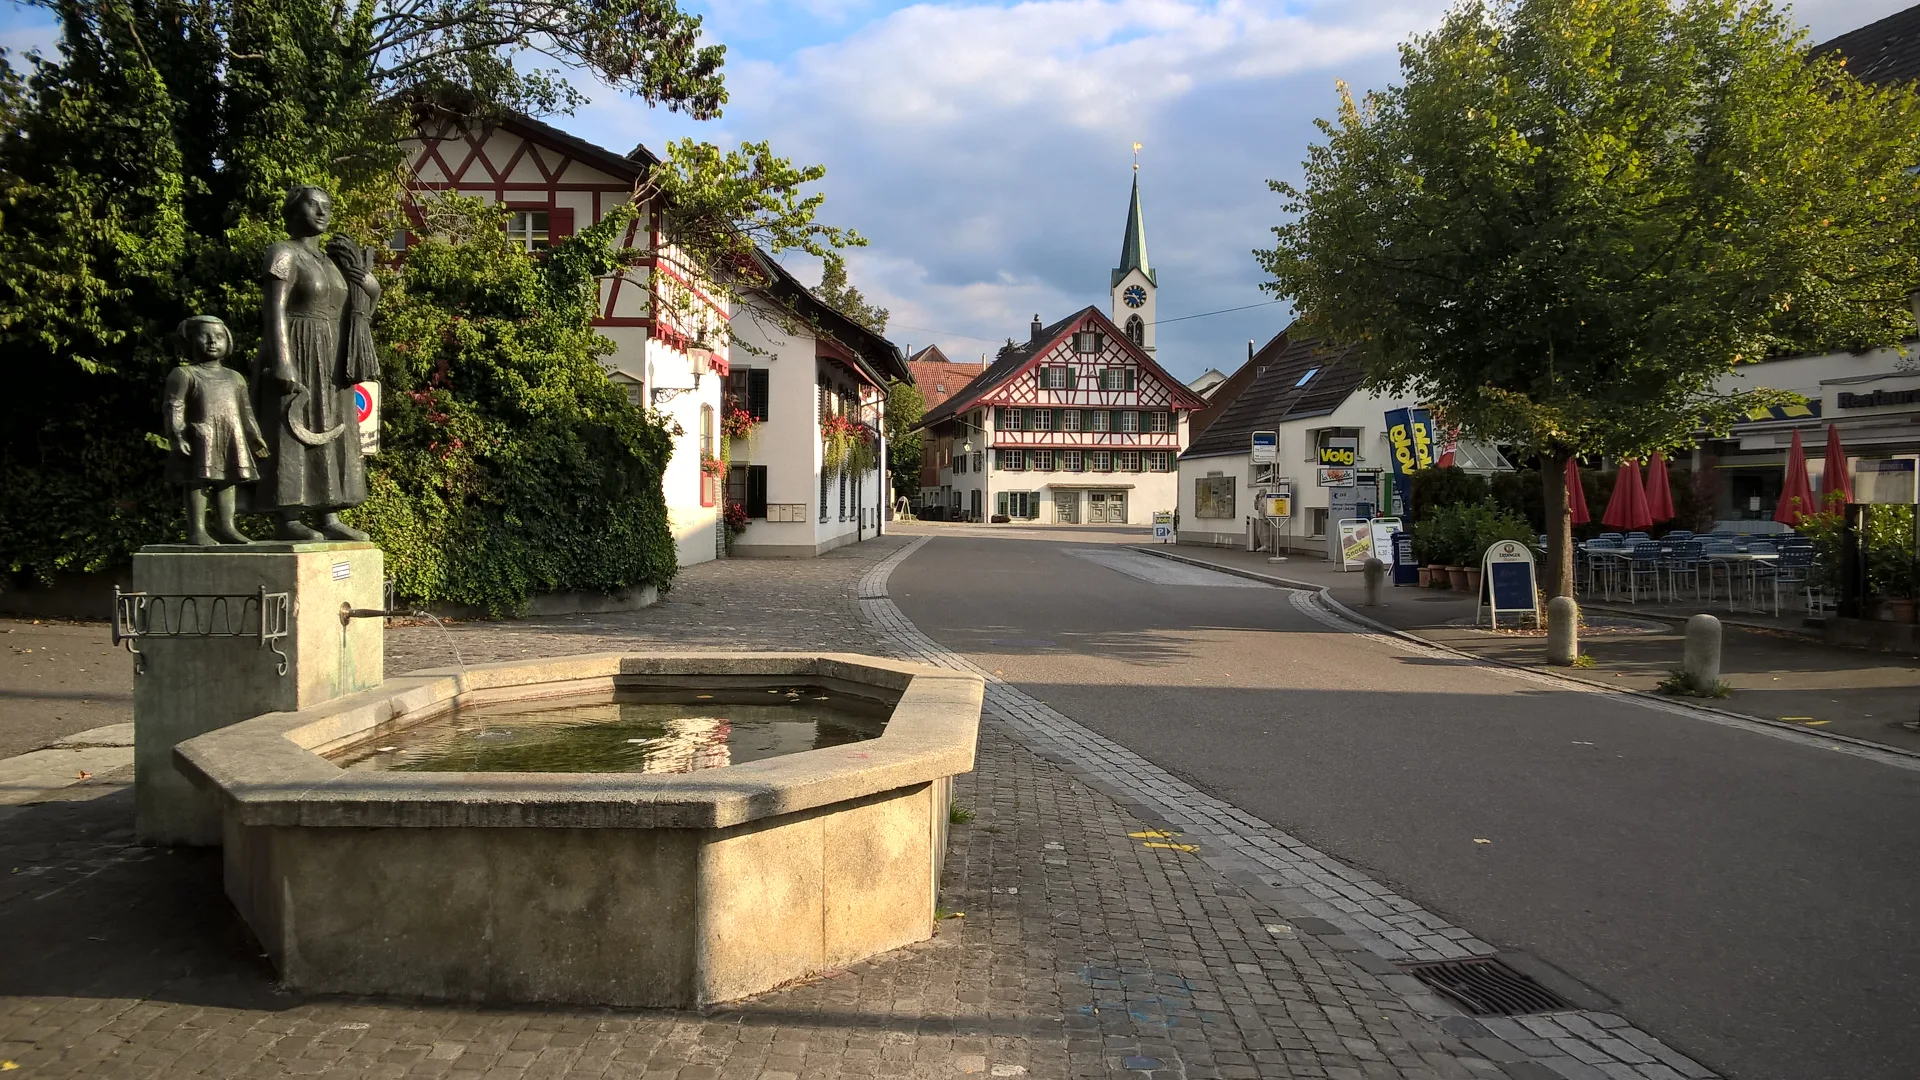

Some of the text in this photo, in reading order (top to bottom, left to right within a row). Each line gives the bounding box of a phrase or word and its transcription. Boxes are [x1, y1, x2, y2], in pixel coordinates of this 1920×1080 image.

[1320, 448, 1354, 465] Volg
[1389, 424, 1415, 475] Volg
[1345, 543, 1370, 559] Snacks
